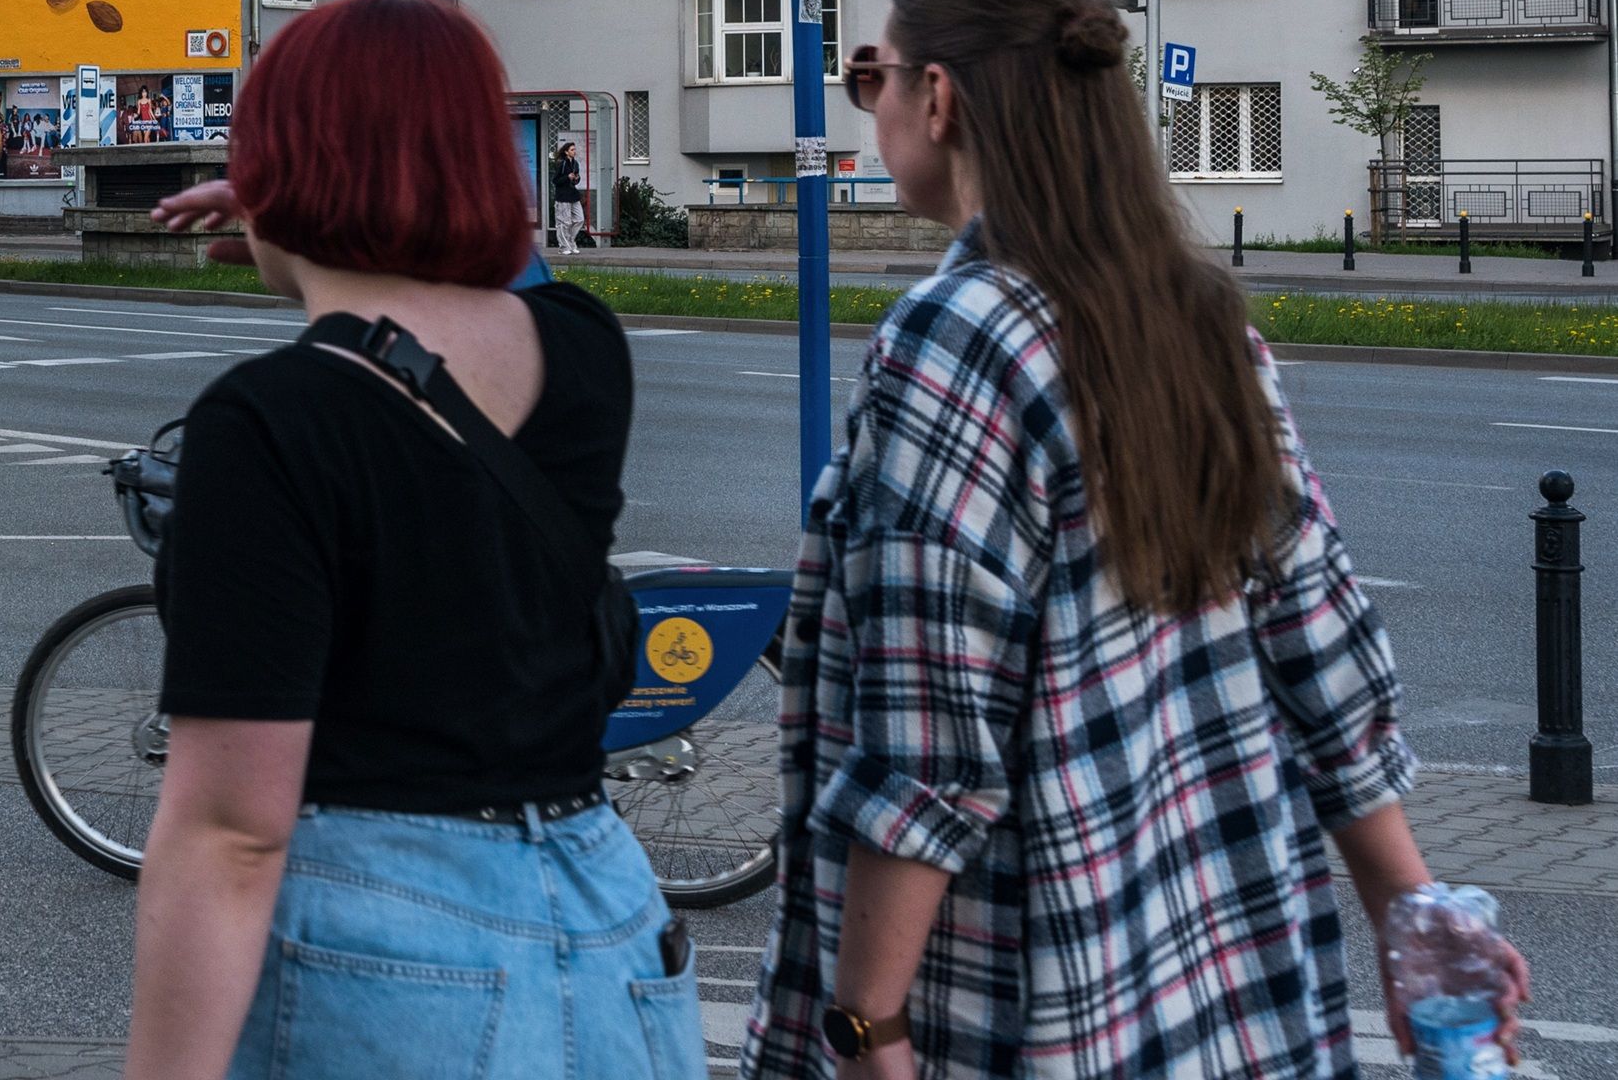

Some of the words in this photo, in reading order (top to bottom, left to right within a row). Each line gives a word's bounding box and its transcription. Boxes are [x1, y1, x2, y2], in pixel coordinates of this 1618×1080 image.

[1171, 48, 1190, 78] P
[175, 77, 202, 85] WELCOME
[175, 101, 202, 109] ORIGINALS
[205, 103, 232, 117] NIEBO
